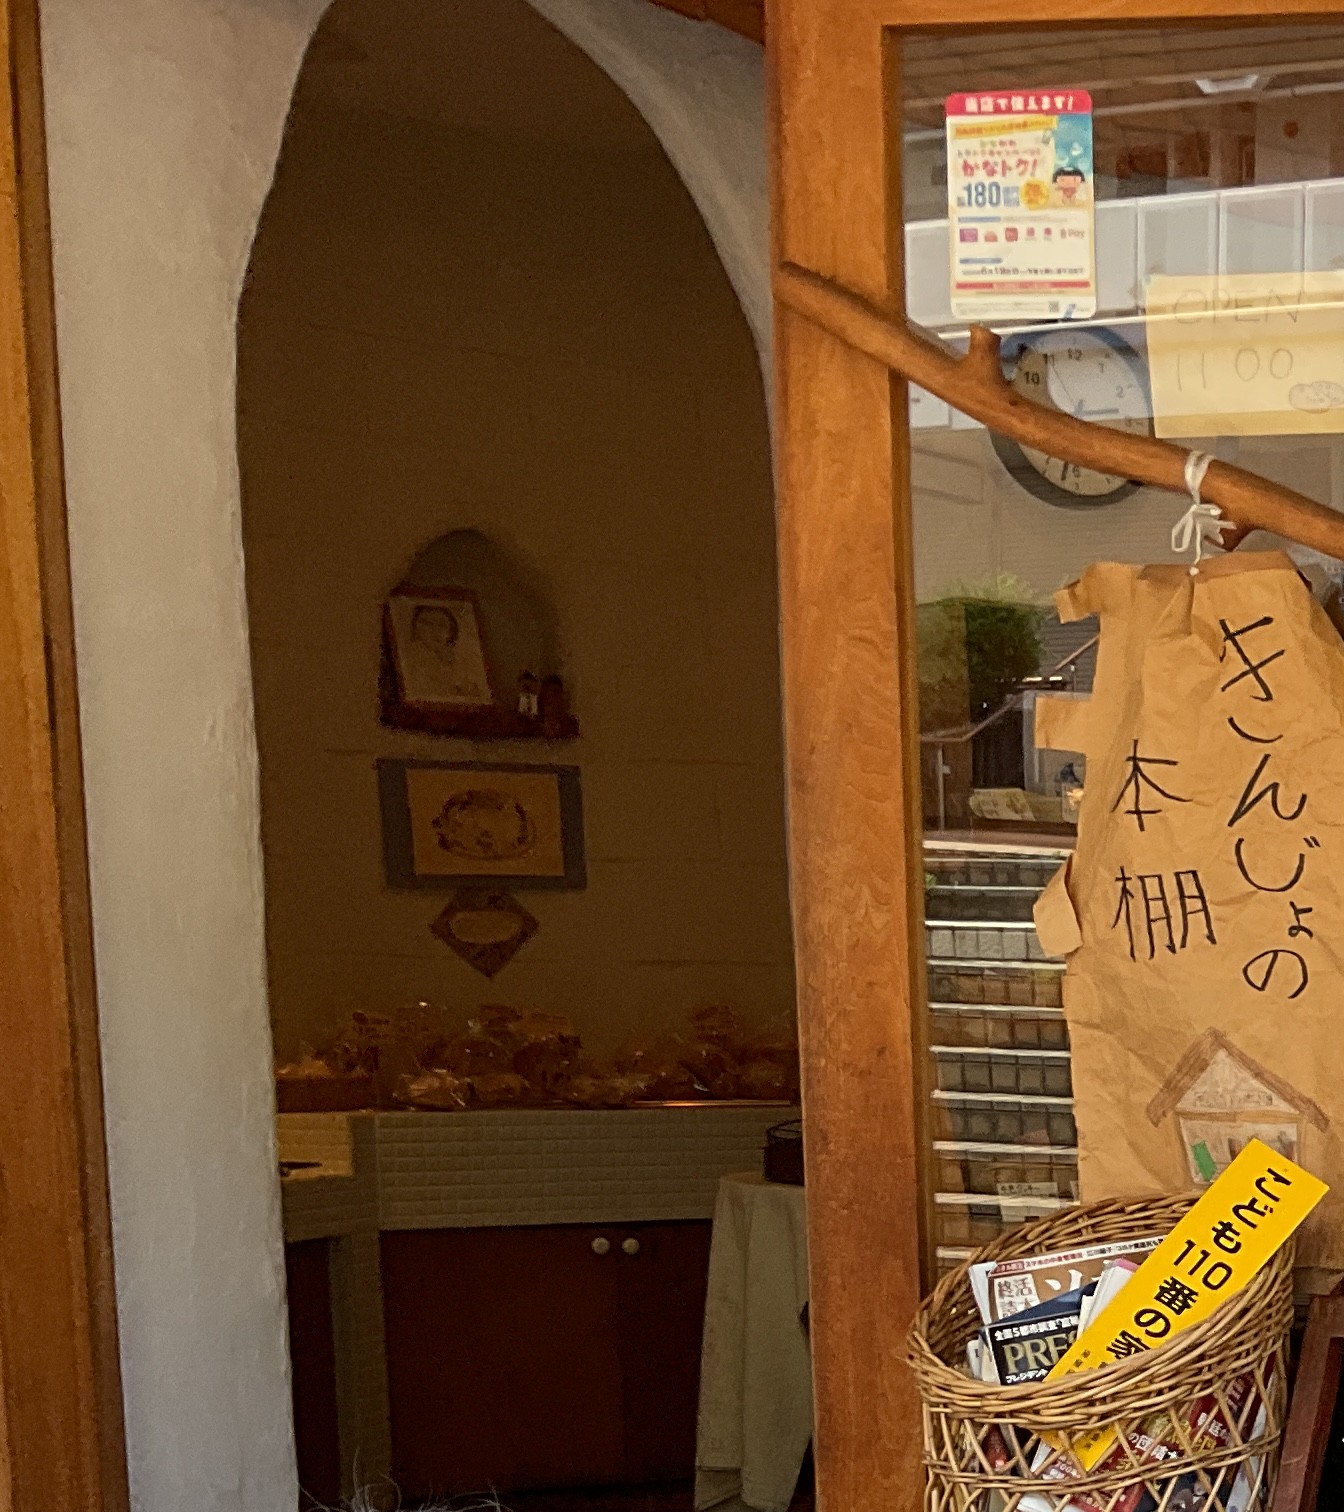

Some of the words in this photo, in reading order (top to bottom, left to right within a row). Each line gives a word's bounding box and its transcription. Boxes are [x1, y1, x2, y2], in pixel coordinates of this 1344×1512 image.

[1173, 289, 1303, 324] OPEN
[1024, 371, 1040, 385] 10
[1110, 737, 1218, 962] 本棚
[1219, 614, 1324, 999] きんじょの
